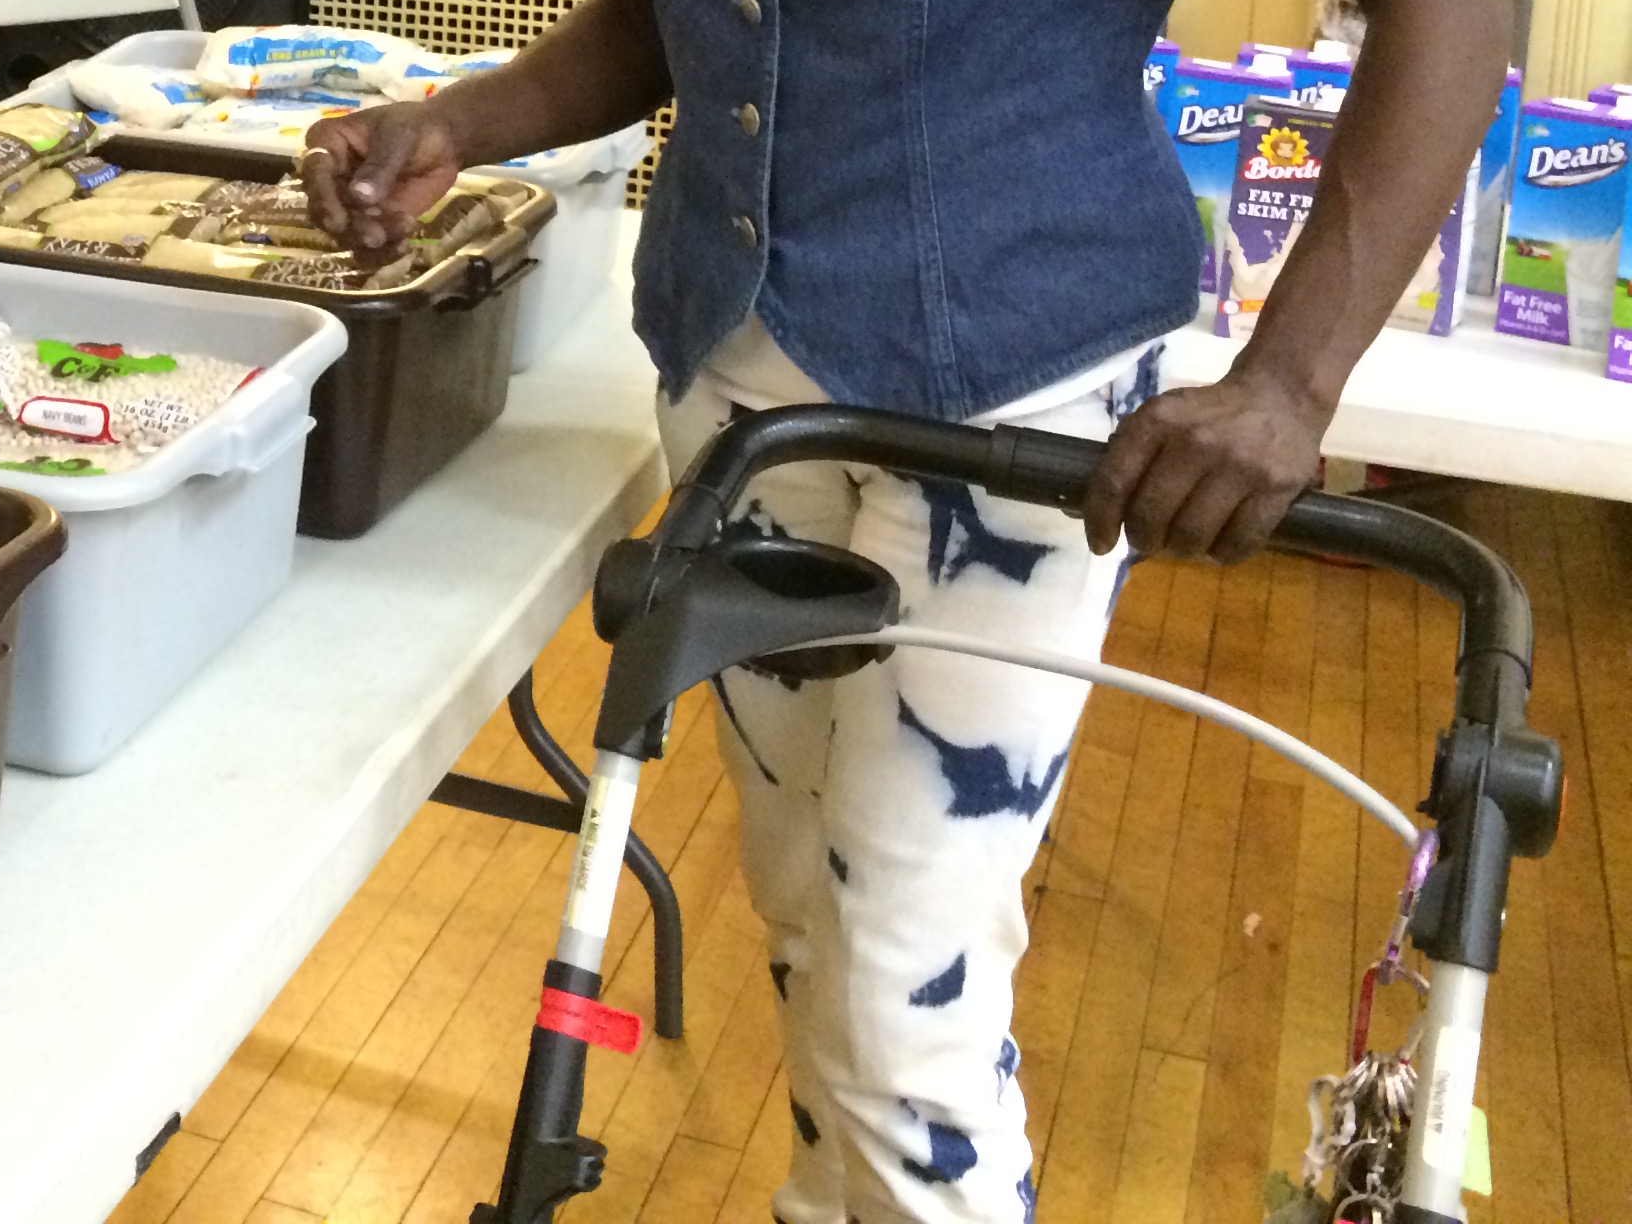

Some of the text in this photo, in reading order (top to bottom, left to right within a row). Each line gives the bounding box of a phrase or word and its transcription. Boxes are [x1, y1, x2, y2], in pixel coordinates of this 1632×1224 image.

[1244, 156, 1321, 180] Bord
[1528, 138, 1627, 178] Dean's
[1249, 188, 1314, 208] FAT FR
[1237, 202, 1289, 220] SKIM
[1503, 290, 1563, 314] Fat Free
[1516, 307, 1549, 326] Milk
[1614, 333, 1632, 352] Fa
[51, 356, 121, 383] C&F
[42, 409, 88, 426] NAVY BEANS
